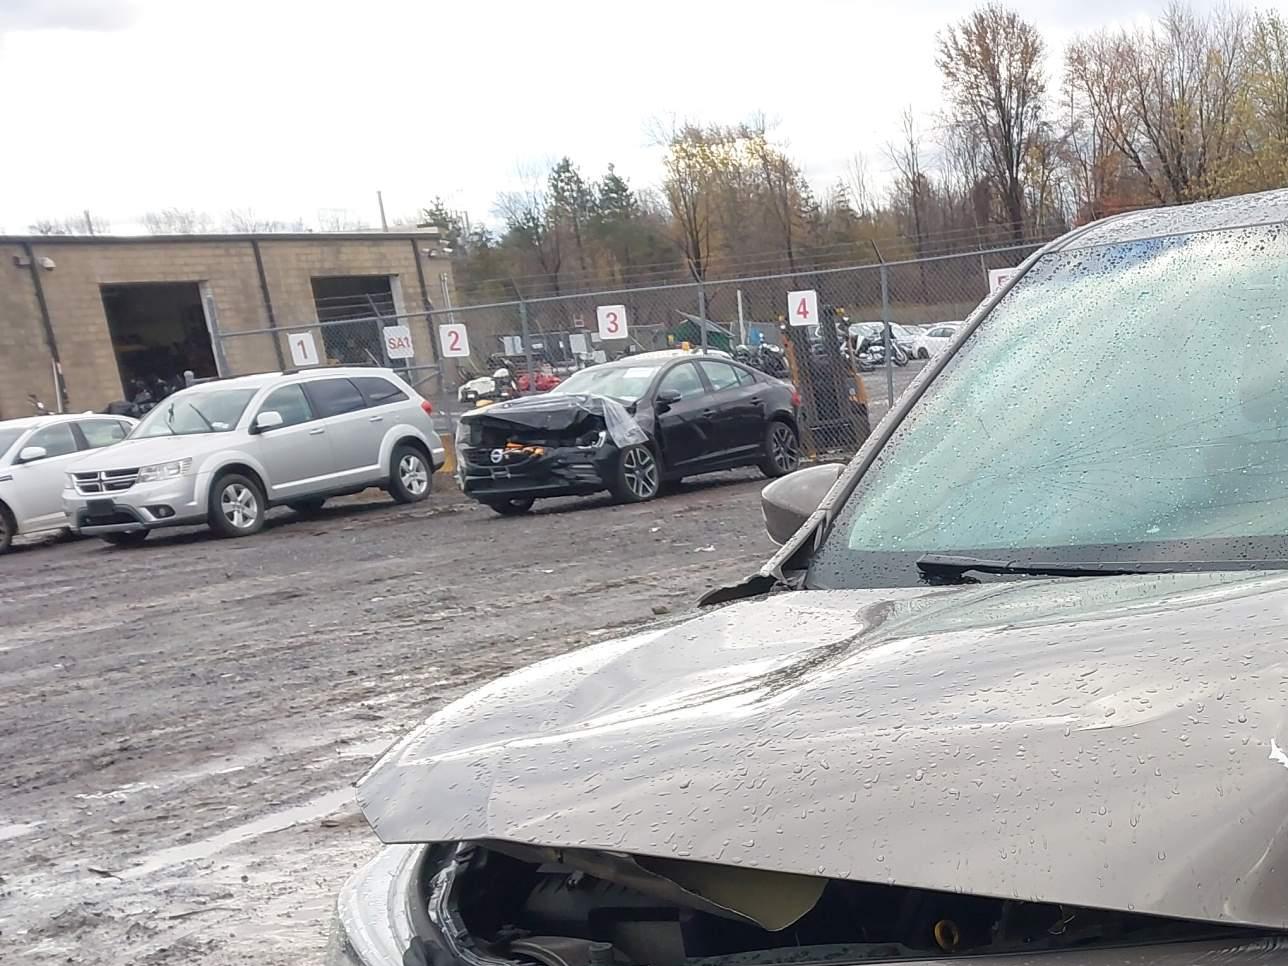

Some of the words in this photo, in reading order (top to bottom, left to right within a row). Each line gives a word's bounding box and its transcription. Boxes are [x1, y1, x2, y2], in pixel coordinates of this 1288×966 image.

[796, 297, 809, 319] 4
[606, 311, 619, 333] 3
[297, 339, 308, 360] 1
[388, 336, 411, 350] SA1
[447, 330, 462, 351] 2
